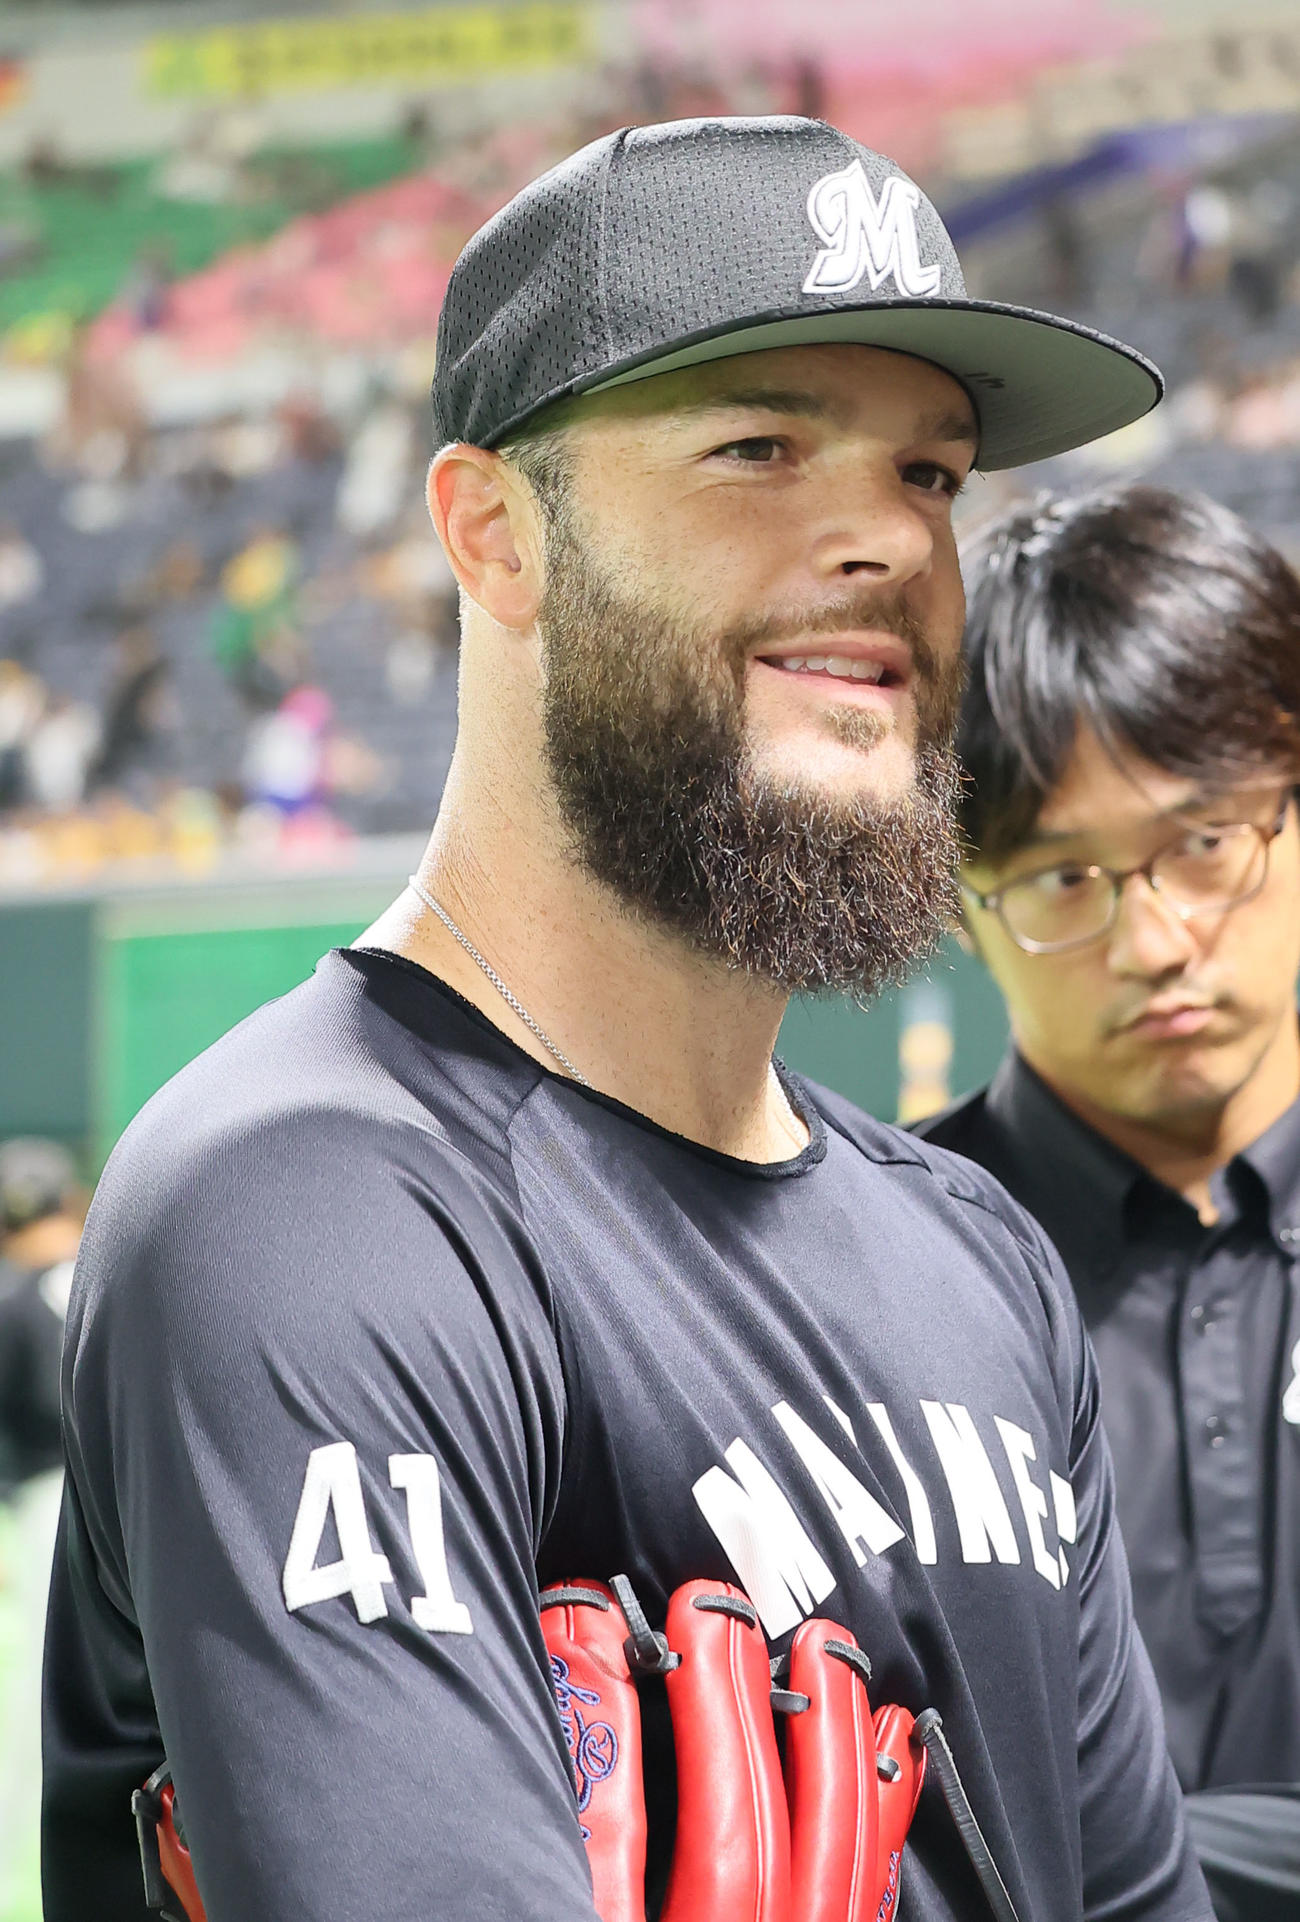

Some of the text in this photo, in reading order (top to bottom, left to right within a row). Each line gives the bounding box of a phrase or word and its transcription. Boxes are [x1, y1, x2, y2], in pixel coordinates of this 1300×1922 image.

[802, 158, 941, 297] M
[282, 1440, 474, 1635] 41
[691, 1395, 1077, 1641] MAINE
